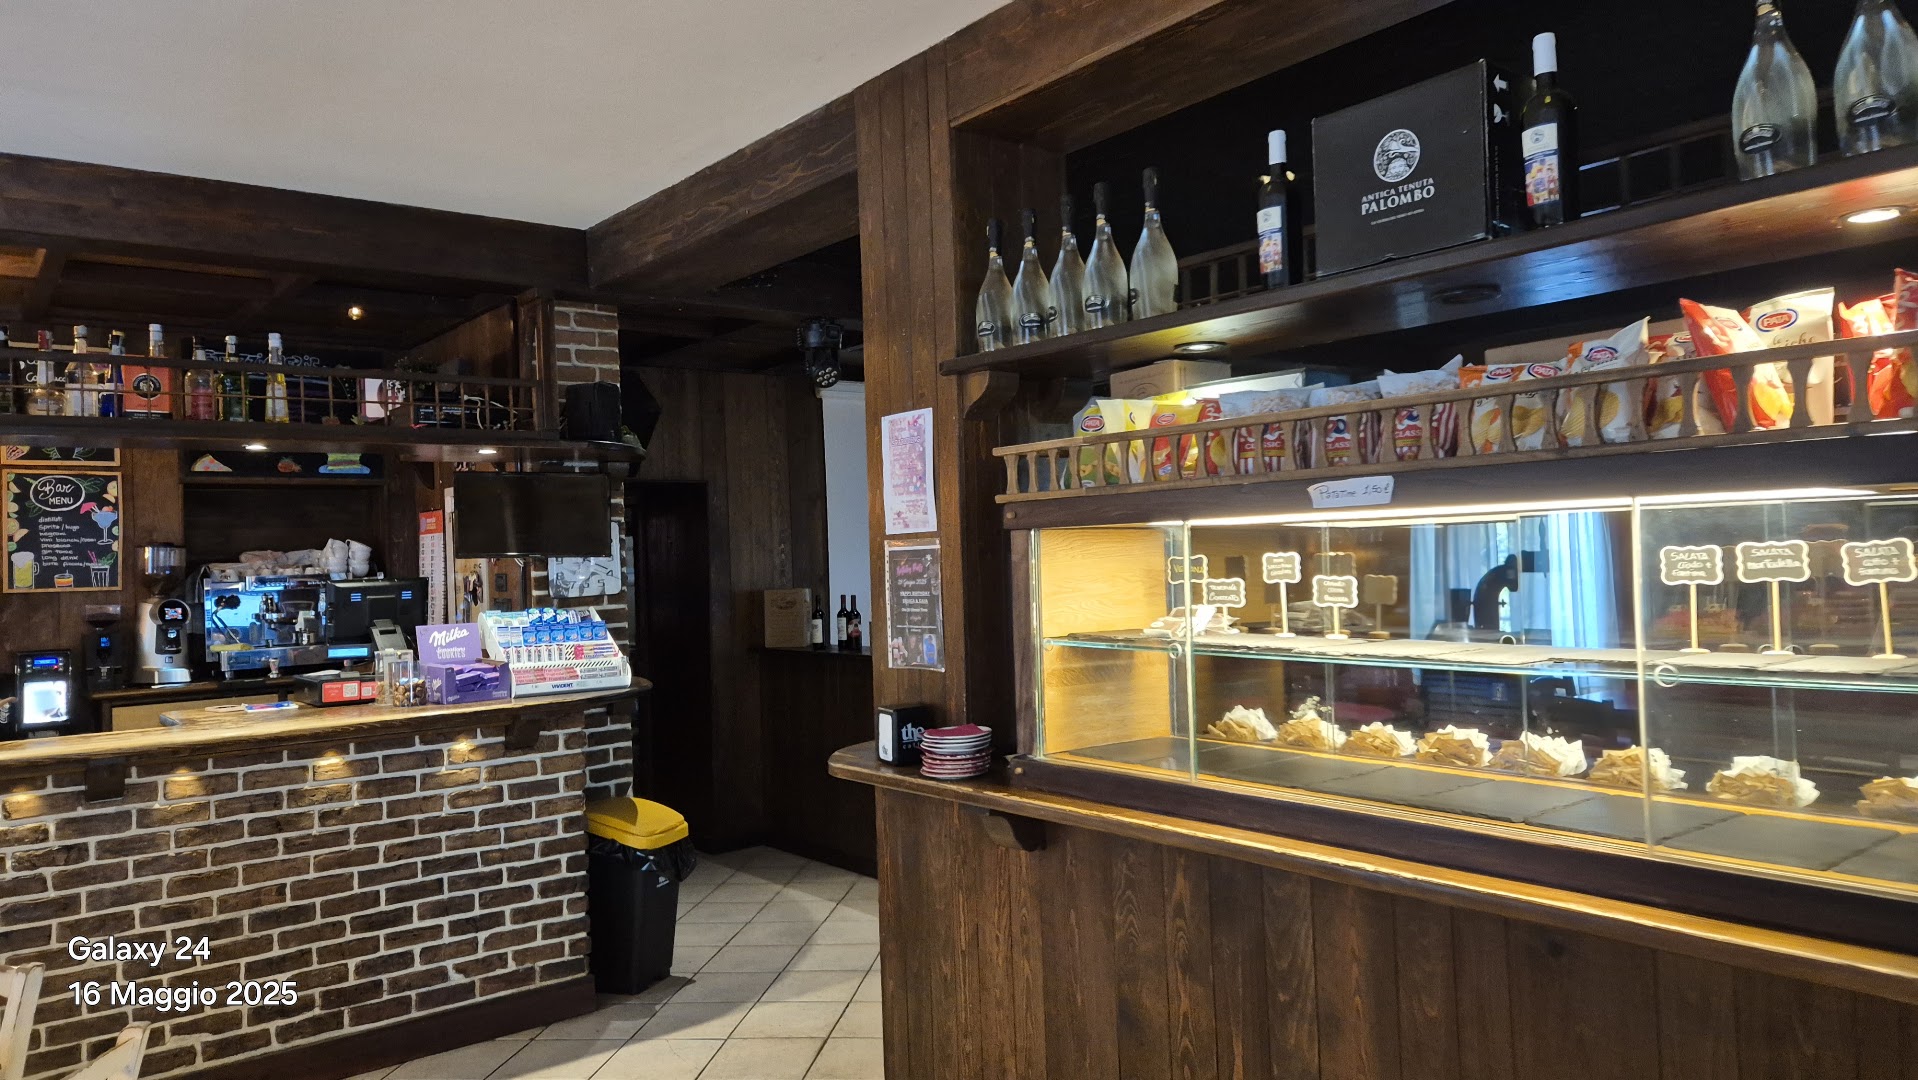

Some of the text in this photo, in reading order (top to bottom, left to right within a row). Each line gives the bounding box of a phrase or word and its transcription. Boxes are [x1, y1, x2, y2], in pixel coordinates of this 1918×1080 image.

[1361, 178, 1434, 203] ANTICA TENUTA
[1361, 185, 1436, 216] PALOMBO
[38, 478, 76, 500] Bar
[48, 496, 74, 505] MENU
[1670, 552, 1710, 561] SALATA
[429, 627, 469, 647] Milka
[901, 722, 924, 741] the
